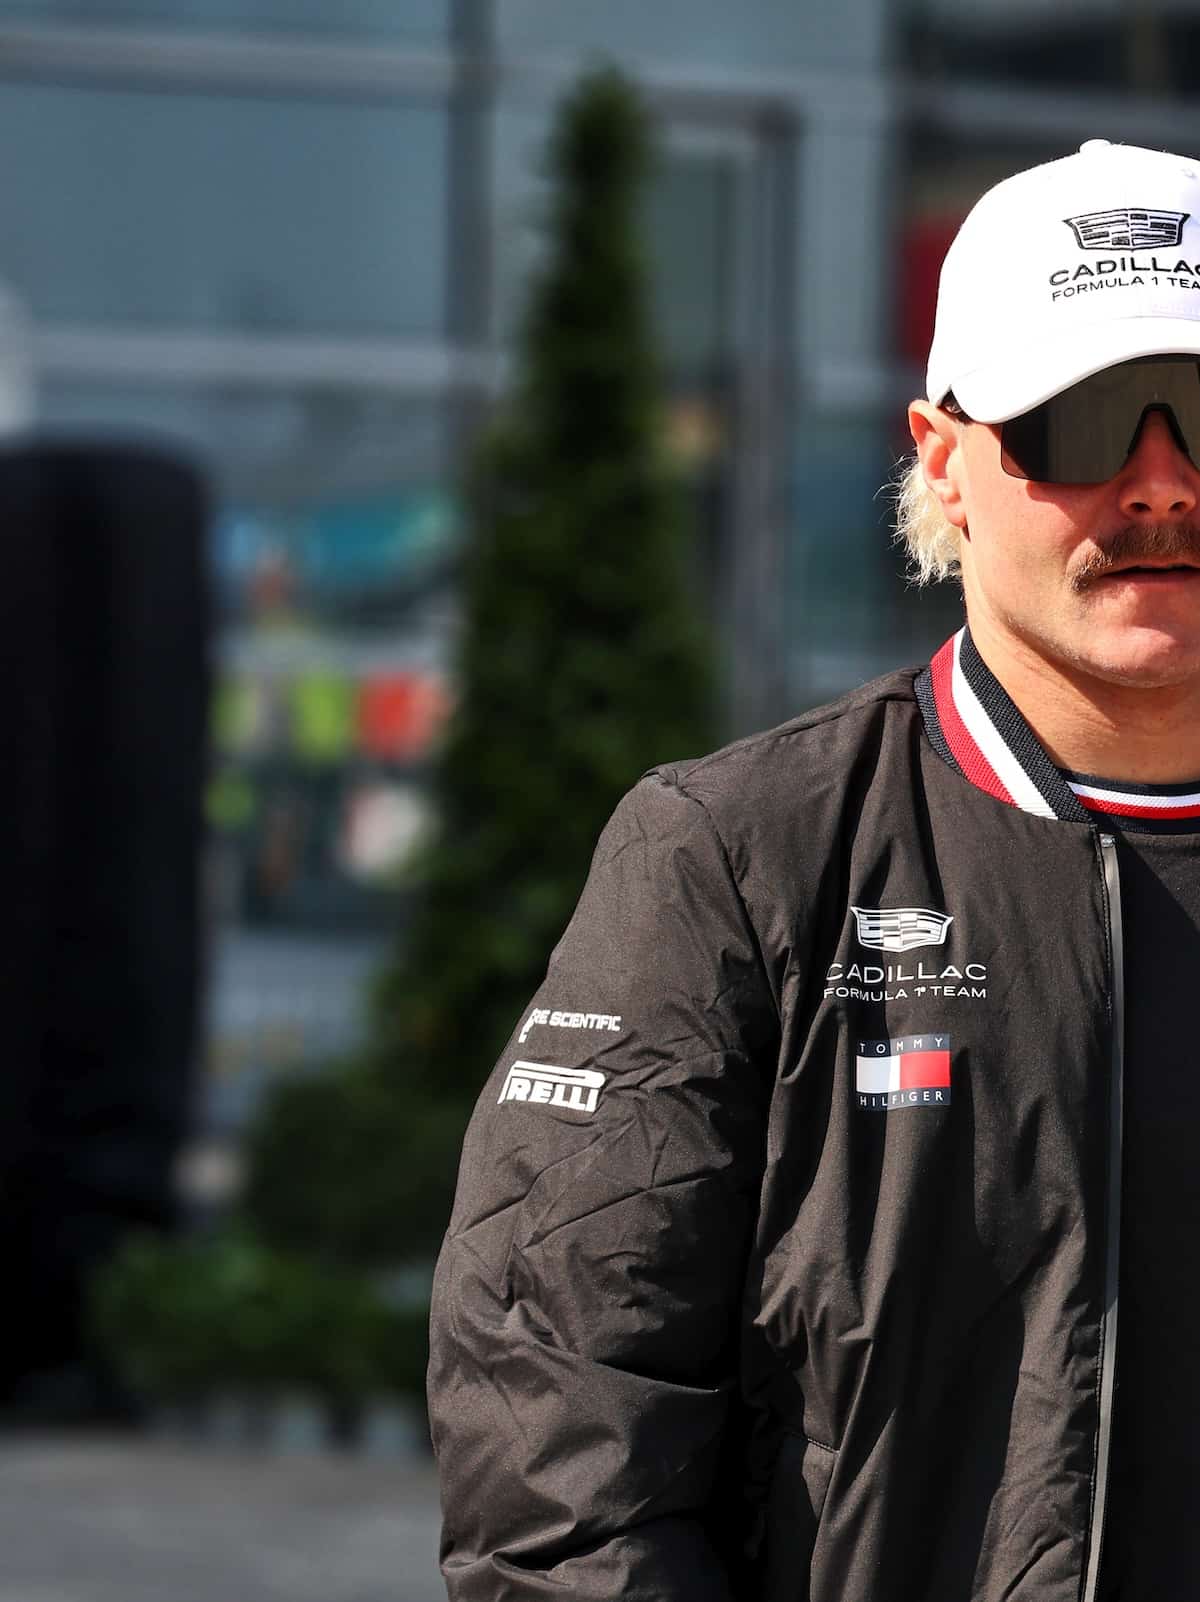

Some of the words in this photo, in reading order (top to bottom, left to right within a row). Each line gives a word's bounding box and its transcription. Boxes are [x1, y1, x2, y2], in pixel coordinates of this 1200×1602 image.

[1052, 276, 1145, 302] FORMULA
[1151, 276, 1159, 286] 1
[826, 962, 987, 983] CADILLAC
[823, 986, 908, 1002] FORMULA
[930, 985, 987, 999] TEAM
[859, 1037, 943, 1054] TOMMY
[497, 1060, 606, 1113] PRELLI
[860, 1091, 943, 1106] HILFIGER
